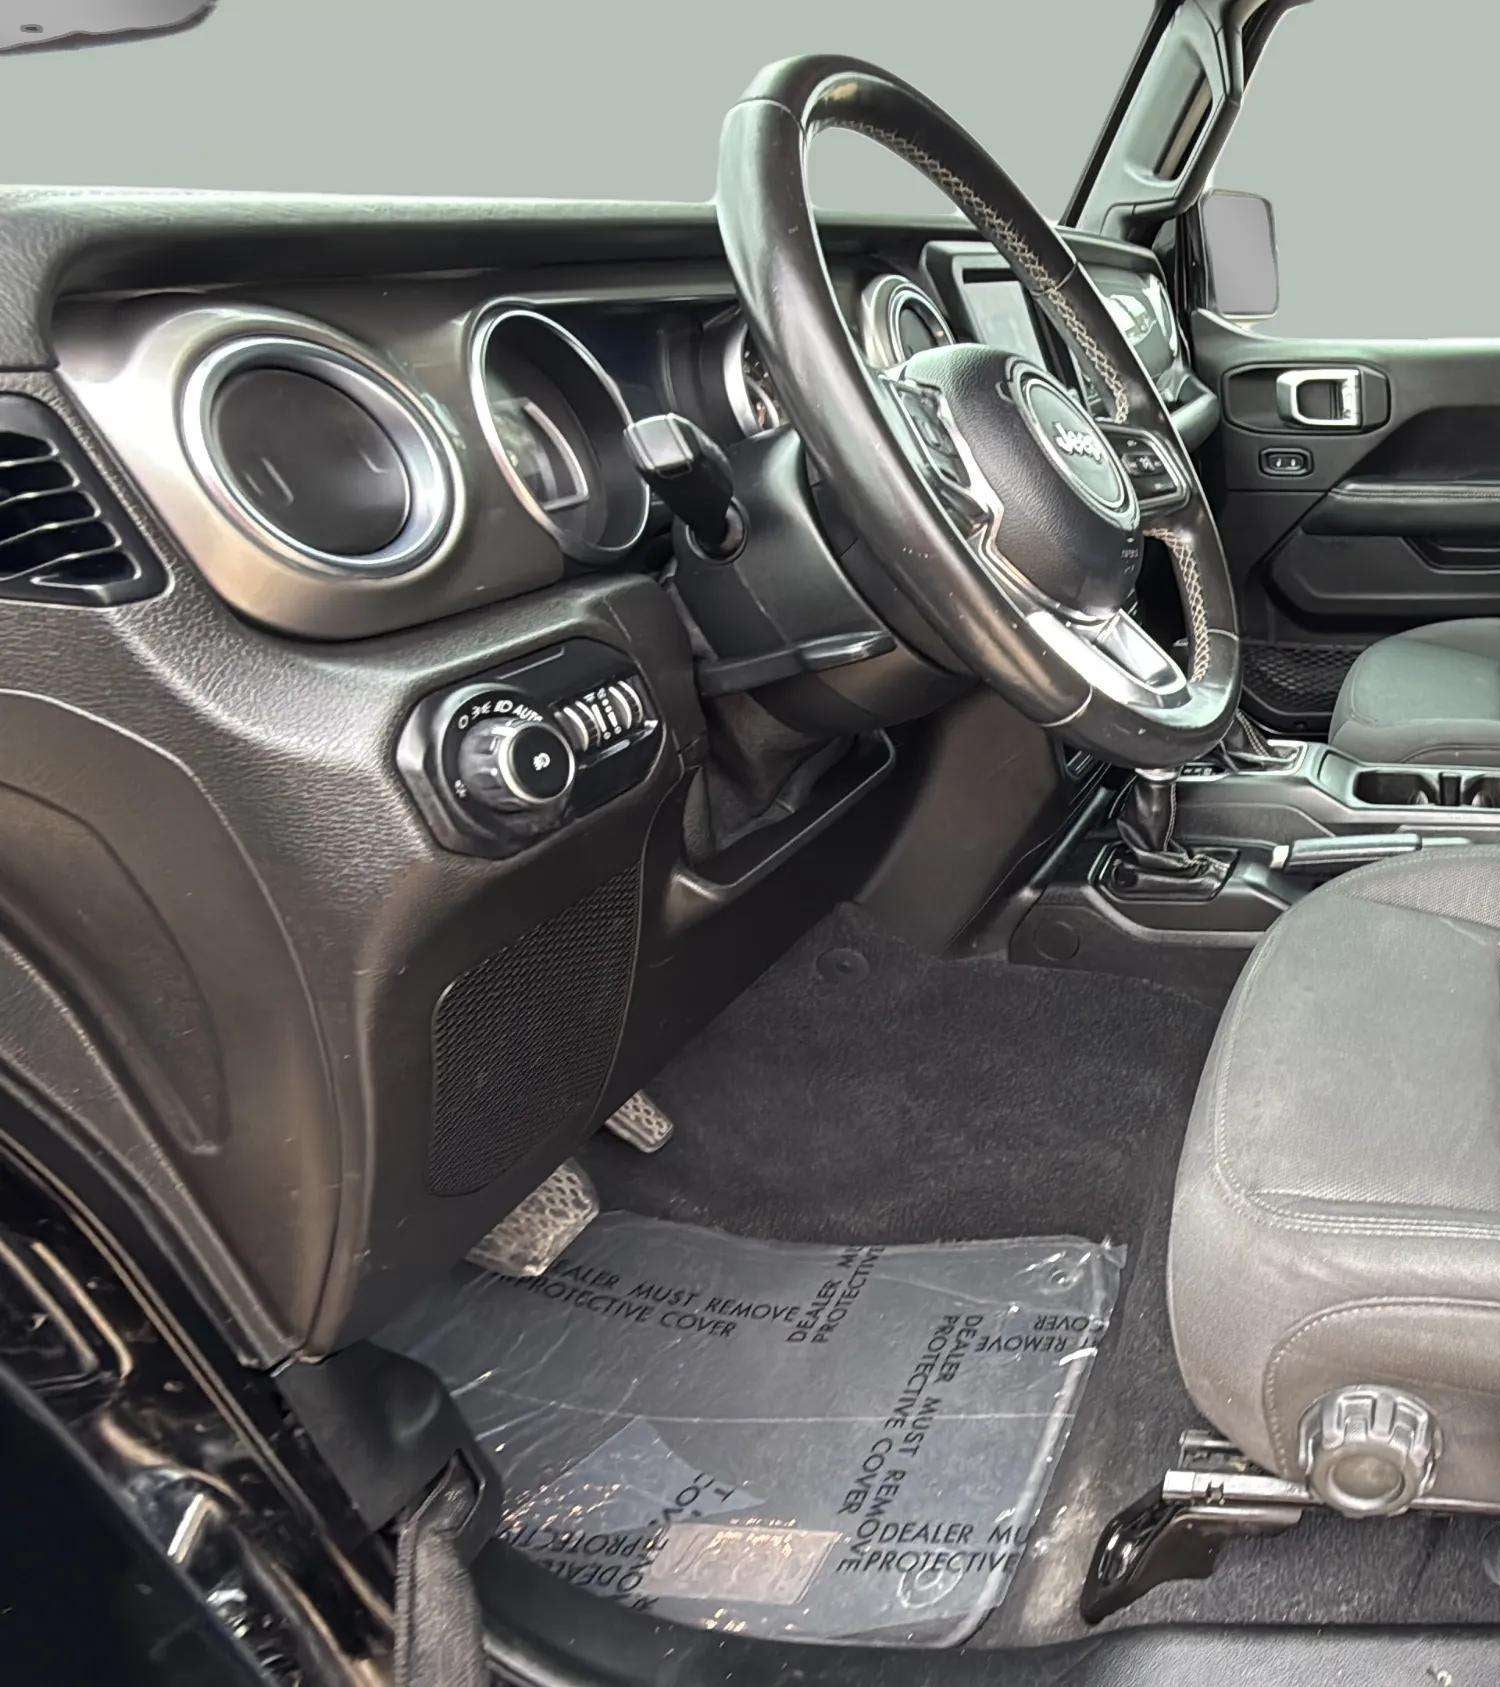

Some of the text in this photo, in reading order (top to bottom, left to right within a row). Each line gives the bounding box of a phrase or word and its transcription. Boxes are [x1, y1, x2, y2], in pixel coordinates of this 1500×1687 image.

[1054, 421, 1102, 462] Jeep
[627, 1280, 698, 1307] MUST
[704, 1296, 801, 1322] REMOVE
[785, 1279, 841, 1343] DEALER
[659, 1311, 737, 1336] COVER
[974, 1334, 1067, 1353] REMOVE
[838, 1314, 961, 1514] PROTECTIVE COVER
[836, 1314, 984, 1572] DEALER MUST REMOVE
[878, 1521, 974, 1544] DEALER
[863, 1550, 1022, 1573] PROTECTIVE
